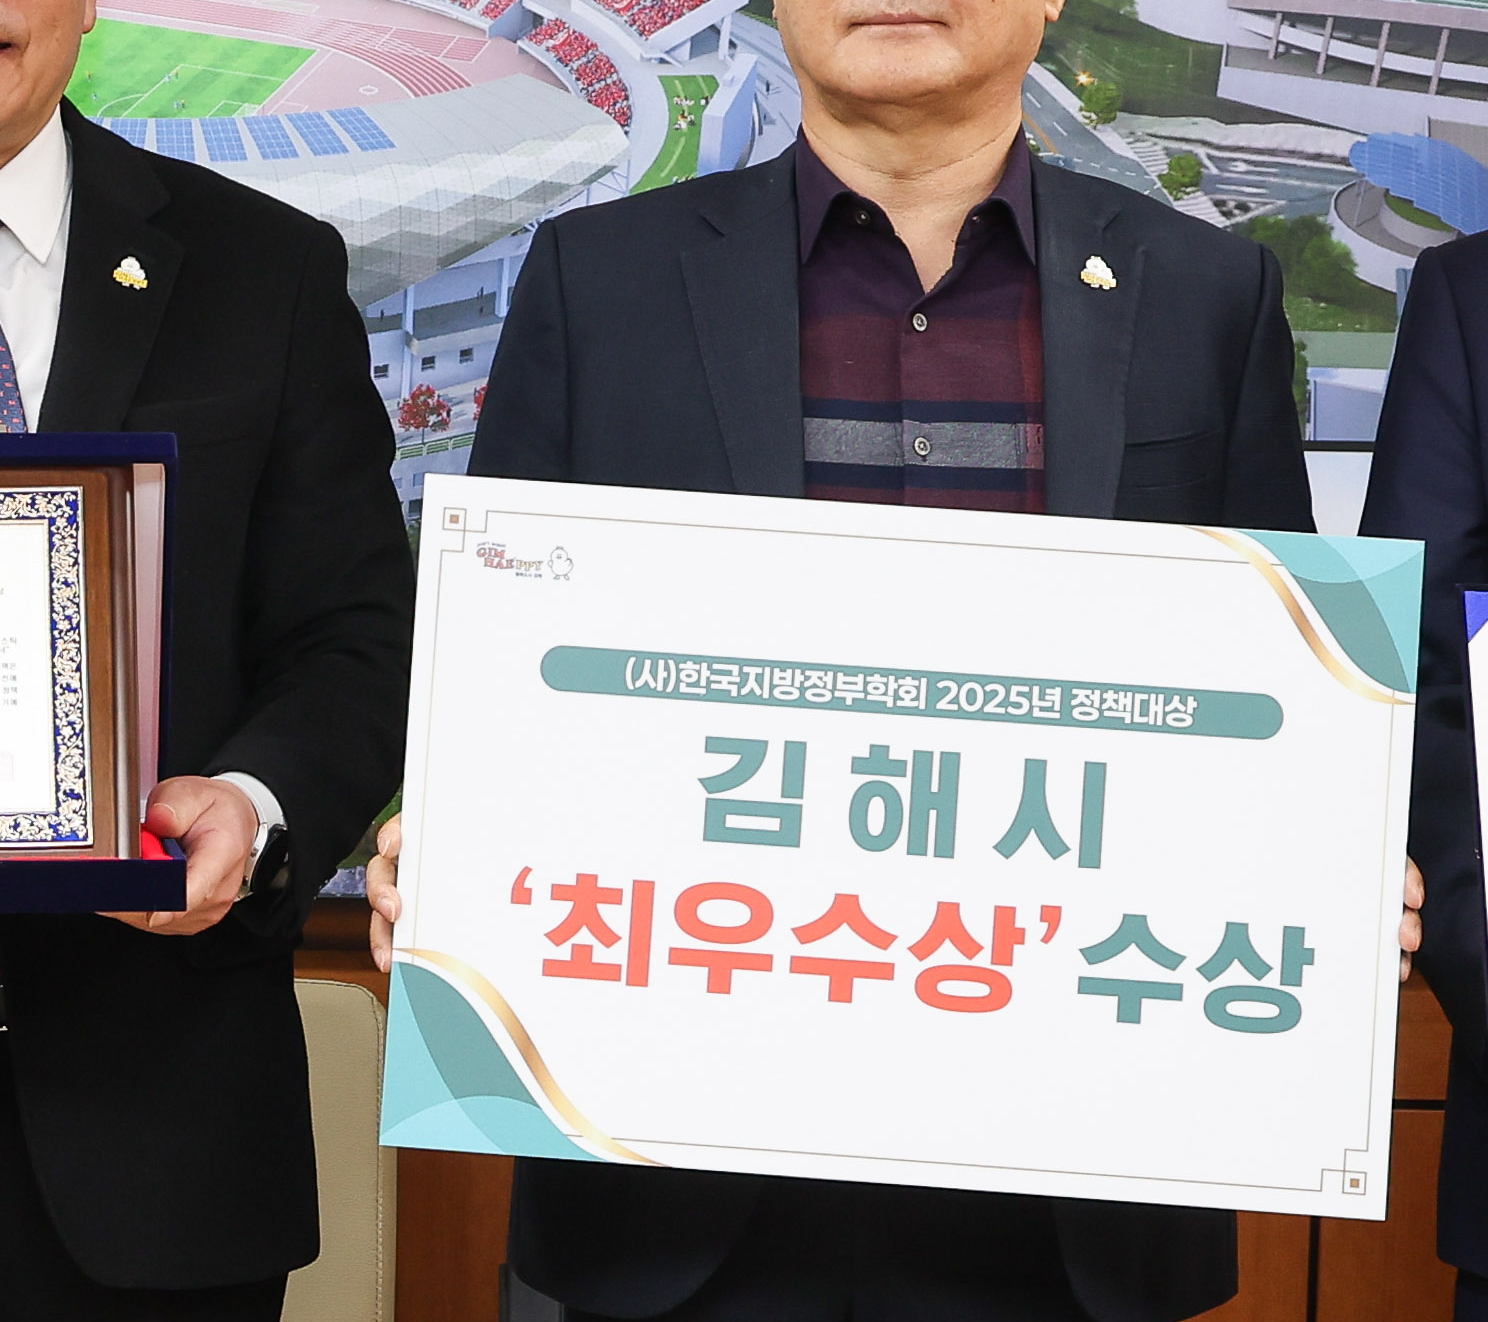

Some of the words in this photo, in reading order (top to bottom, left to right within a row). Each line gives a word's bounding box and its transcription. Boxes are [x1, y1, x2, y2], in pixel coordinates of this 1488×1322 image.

[624, 656, 928, 711] (사)한국지방정부학회
[935, 678, 1062, 720] 2025년
[1069, 686, 1198, 729] 정책대상
